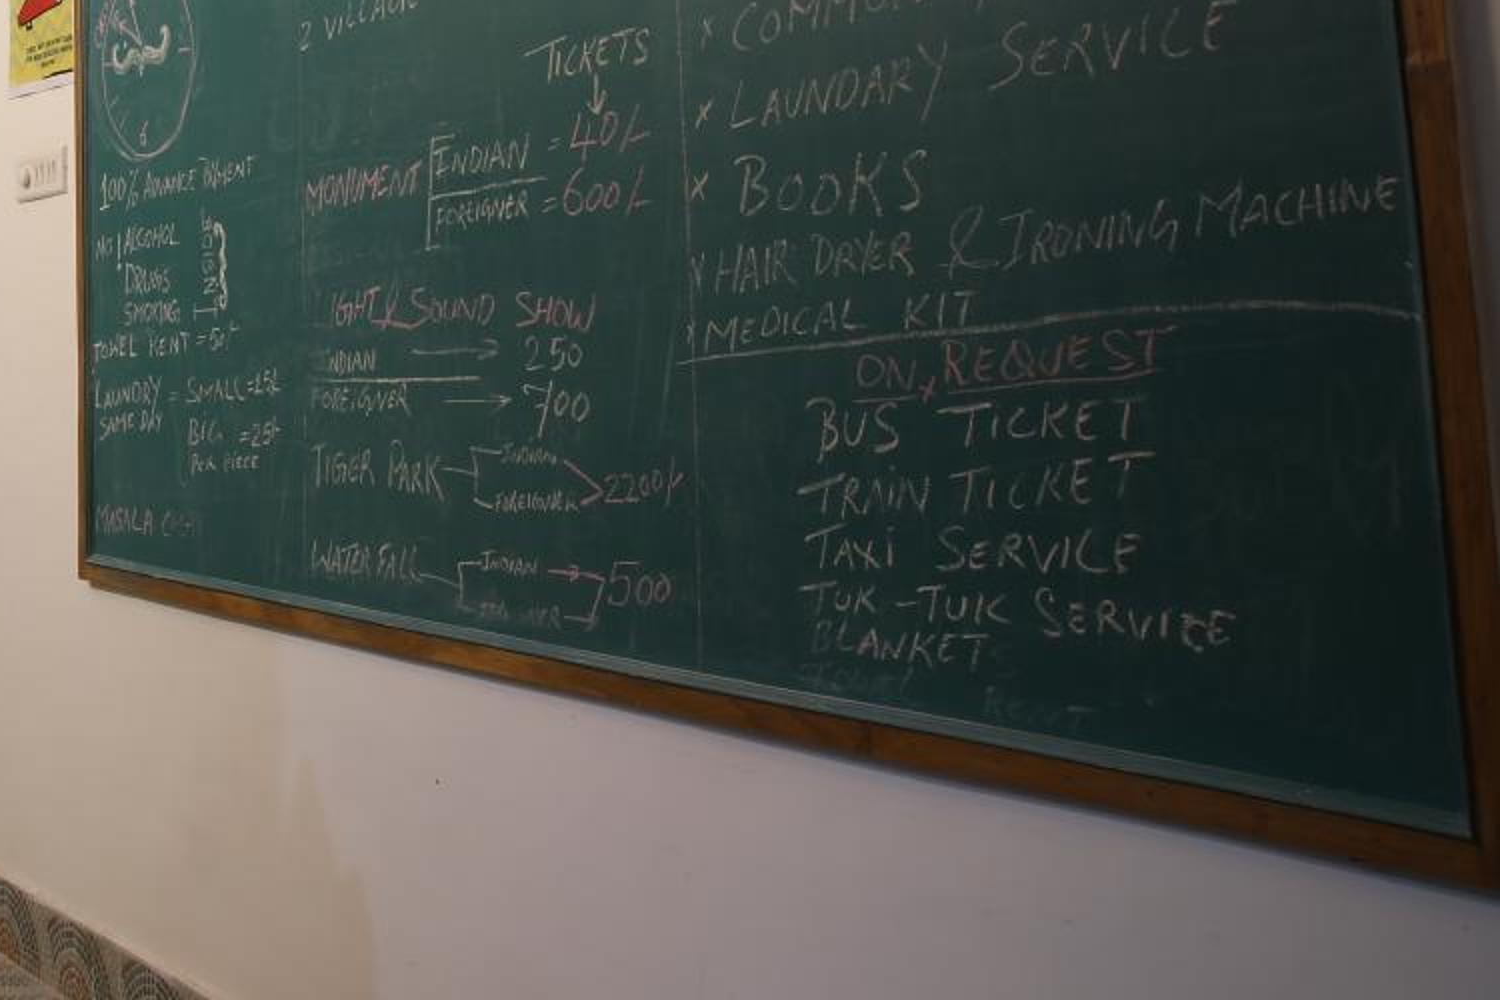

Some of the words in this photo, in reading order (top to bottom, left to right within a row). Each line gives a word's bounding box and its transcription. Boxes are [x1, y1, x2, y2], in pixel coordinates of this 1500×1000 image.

[523, 26, 650, 85] TICKETS
[730, 40, 951, 128] LAUNDARY
[304, 157, 424, 216] MONUMENT
[733, 148, 928, 218] BOOKS
[714, 238, 797, 294] HAIR
[998, 198, 1180, 272] IRONING
[1196, 173, 1400, 238] MACHINE
[410, 286, 496, 328] SOUND
[514, 290, 595, 331] SHOW
[704, 299, 867, 351] MEDICAL
[903, 290, 982, 330] KIT
[524, 335, 583, 372] 250
[941, 325, 1179, 386] REQUEST
[521, 378, 591, 439] 700
[805, 396, 901, 463] BUS
[935, 395, 1152, 447] TICKET
[310, 442, 376, 488] TIGER
[387, 439, 444, 502] PARK
[798, 464, 933, 516] TRAIN
[948, 450, 1157, 514] TICKET
[935, 525, 1142, 575] SERVICE
[607, 560, 673, 607] 500
[811, 619, 990, 667] BLANKET
